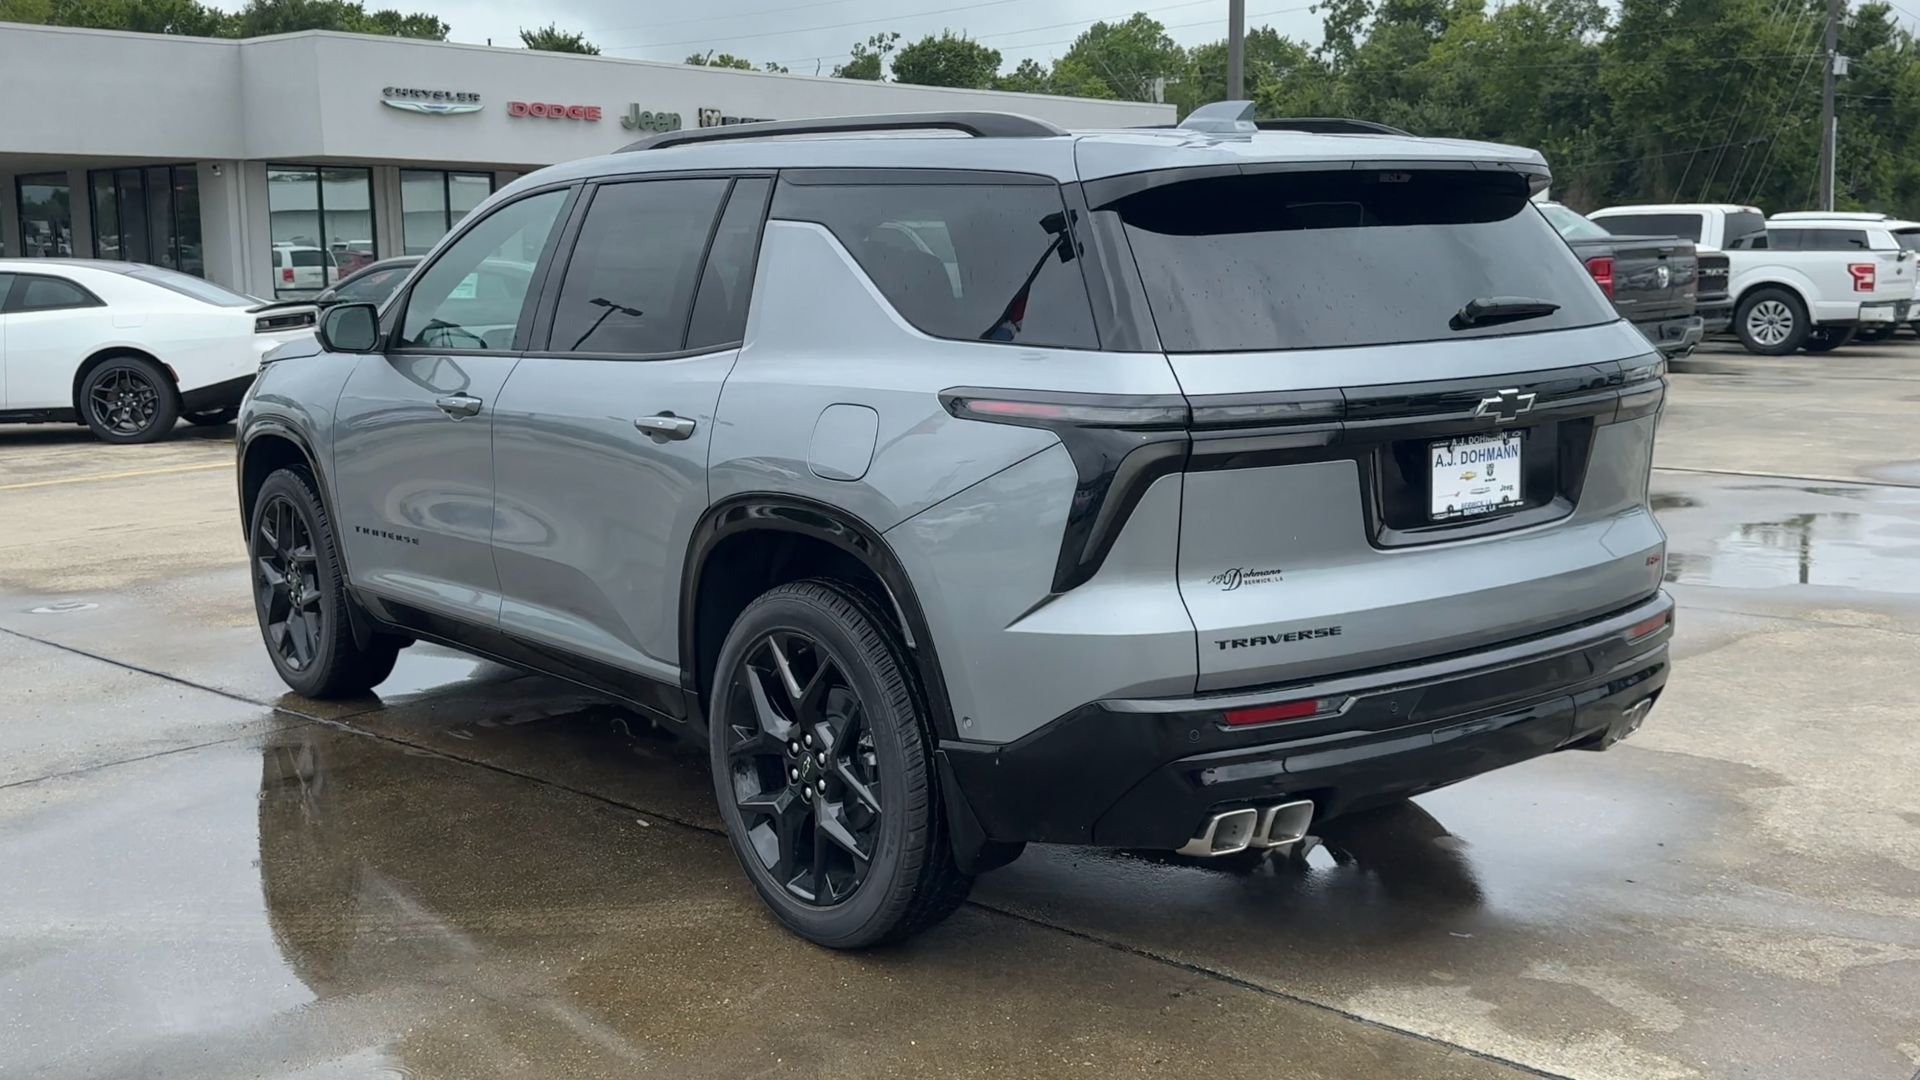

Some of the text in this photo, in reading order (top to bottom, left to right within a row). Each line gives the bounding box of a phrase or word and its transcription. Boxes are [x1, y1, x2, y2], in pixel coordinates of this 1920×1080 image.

[382, 86, 481, 101] CHRYSLER
[507, 101, 602, 122] DODGE
[620, 102, 682, 132] Jeep
[1435, 444, 1518, 468] A.J. DOHMANN
[355, 526, 419, 545] TRAVERSE
[1214, 626, 1343, 651] TRAVERSE
